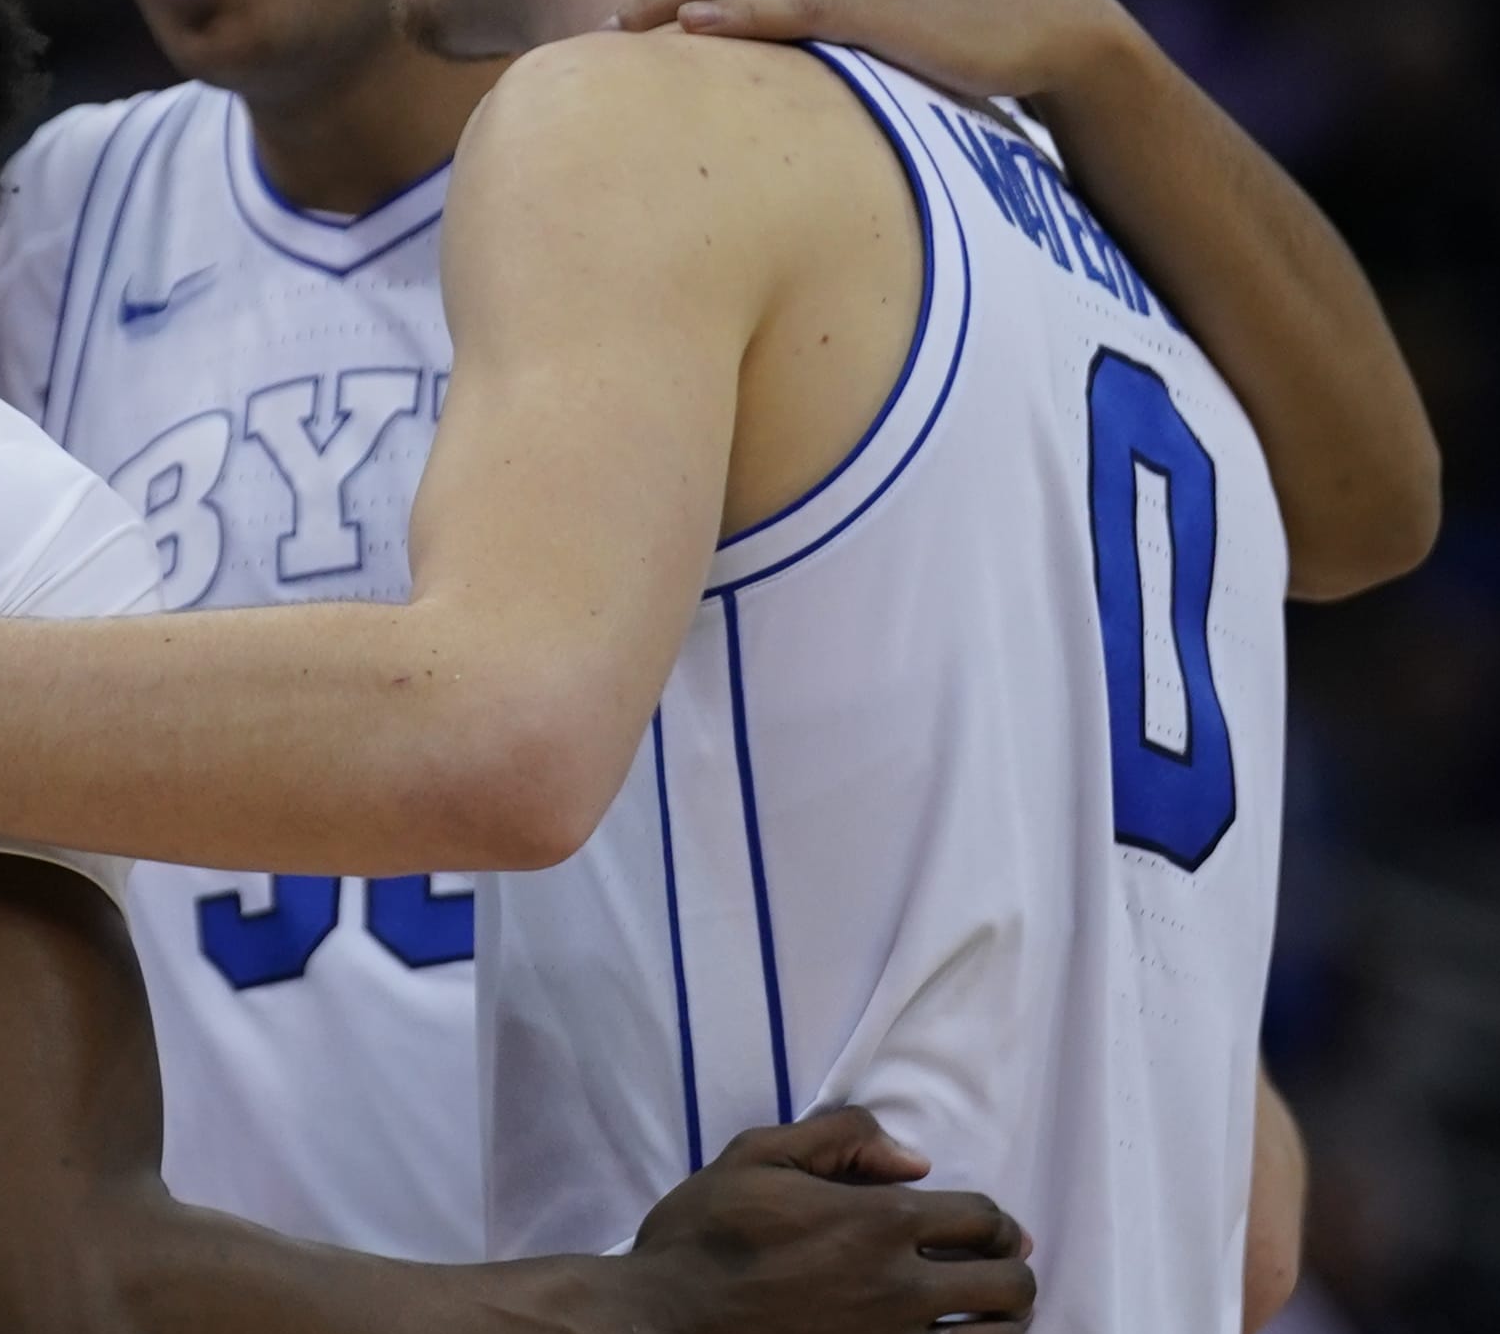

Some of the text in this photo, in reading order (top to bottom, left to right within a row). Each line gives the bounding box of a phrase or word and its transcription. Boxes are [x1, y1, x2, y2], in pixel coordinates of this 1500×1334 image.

[928, 102, 1186, 335] WATER
[106, 365, 450, 612] BY
[1086, 345, 1236, 874] 0
